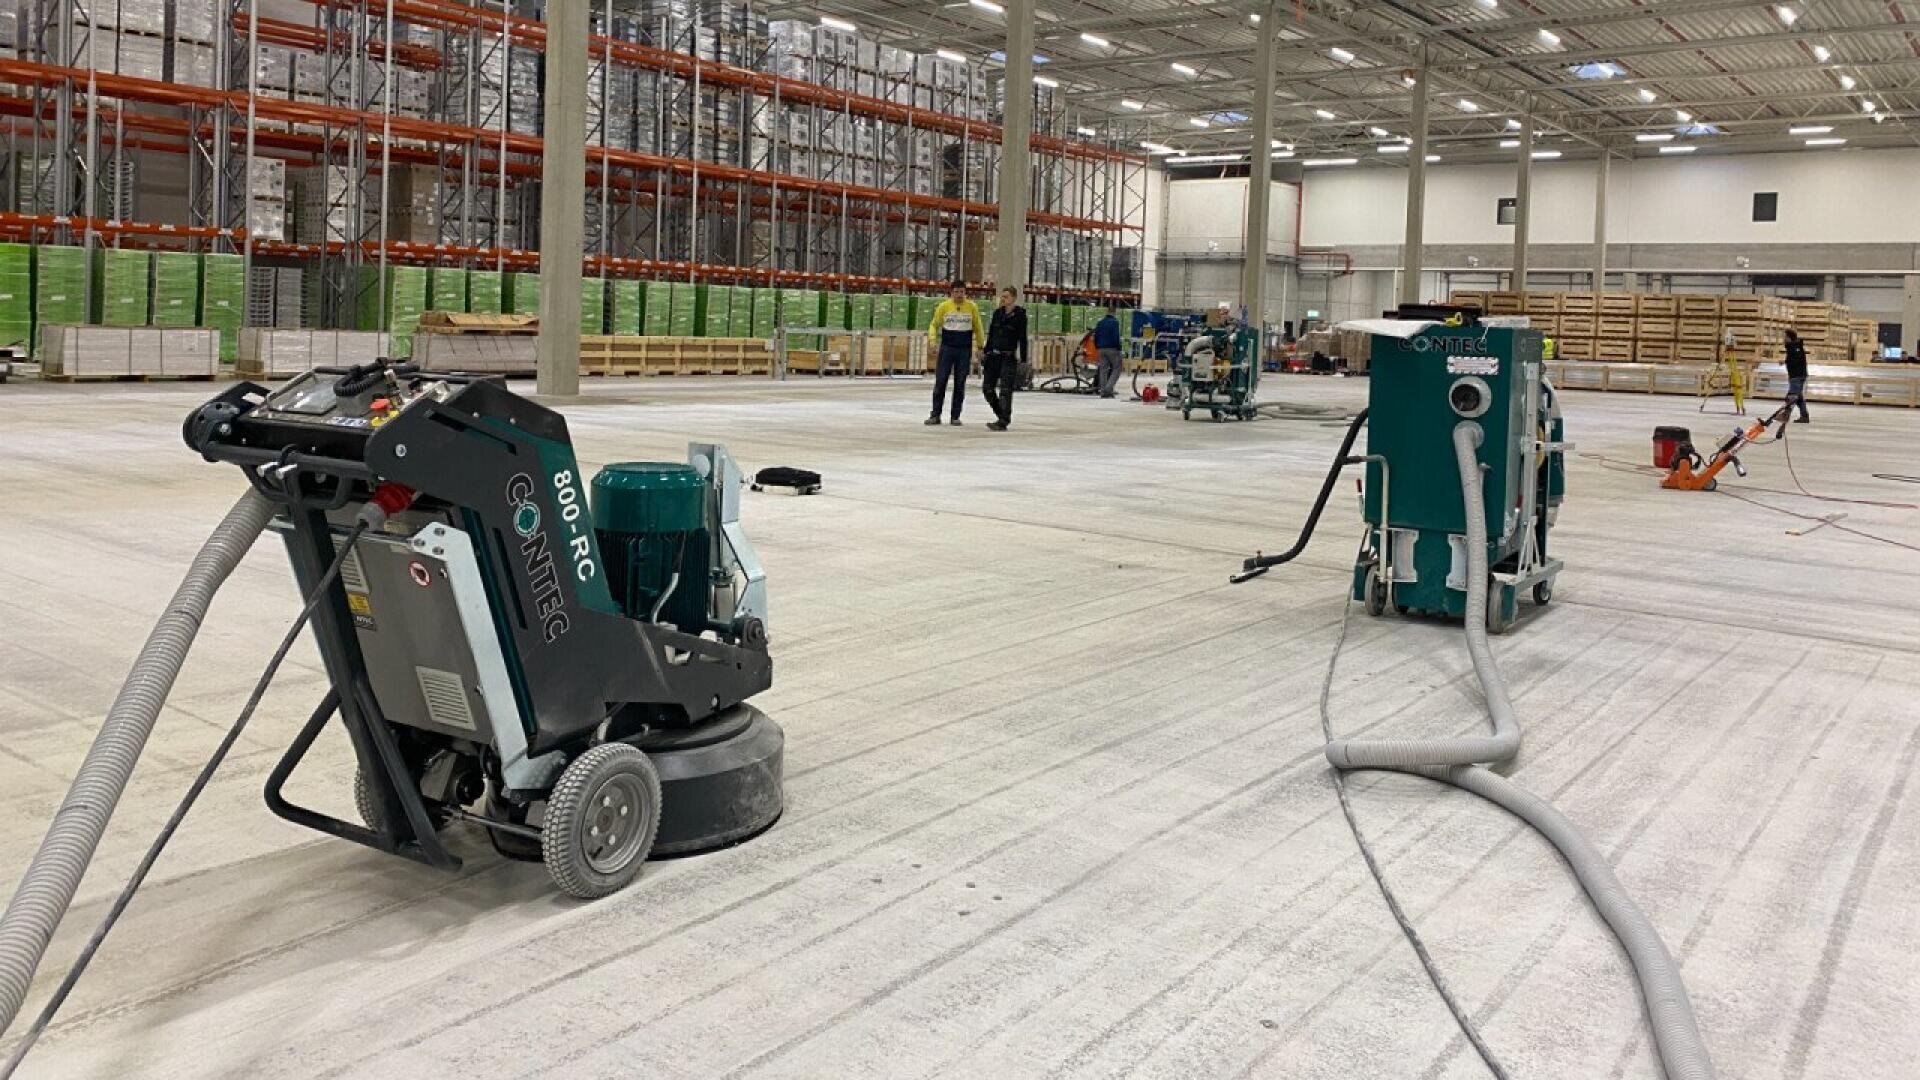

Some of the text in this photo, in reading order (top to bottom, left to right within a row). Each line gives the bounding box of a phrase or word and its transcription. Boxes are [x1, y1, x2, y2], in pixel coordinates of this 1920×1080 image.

[1397, 336, 1487, 353] CONTEC
[507, 473, 569, 644] CONTEC
[554, 470, 594, 581] 800-RC
